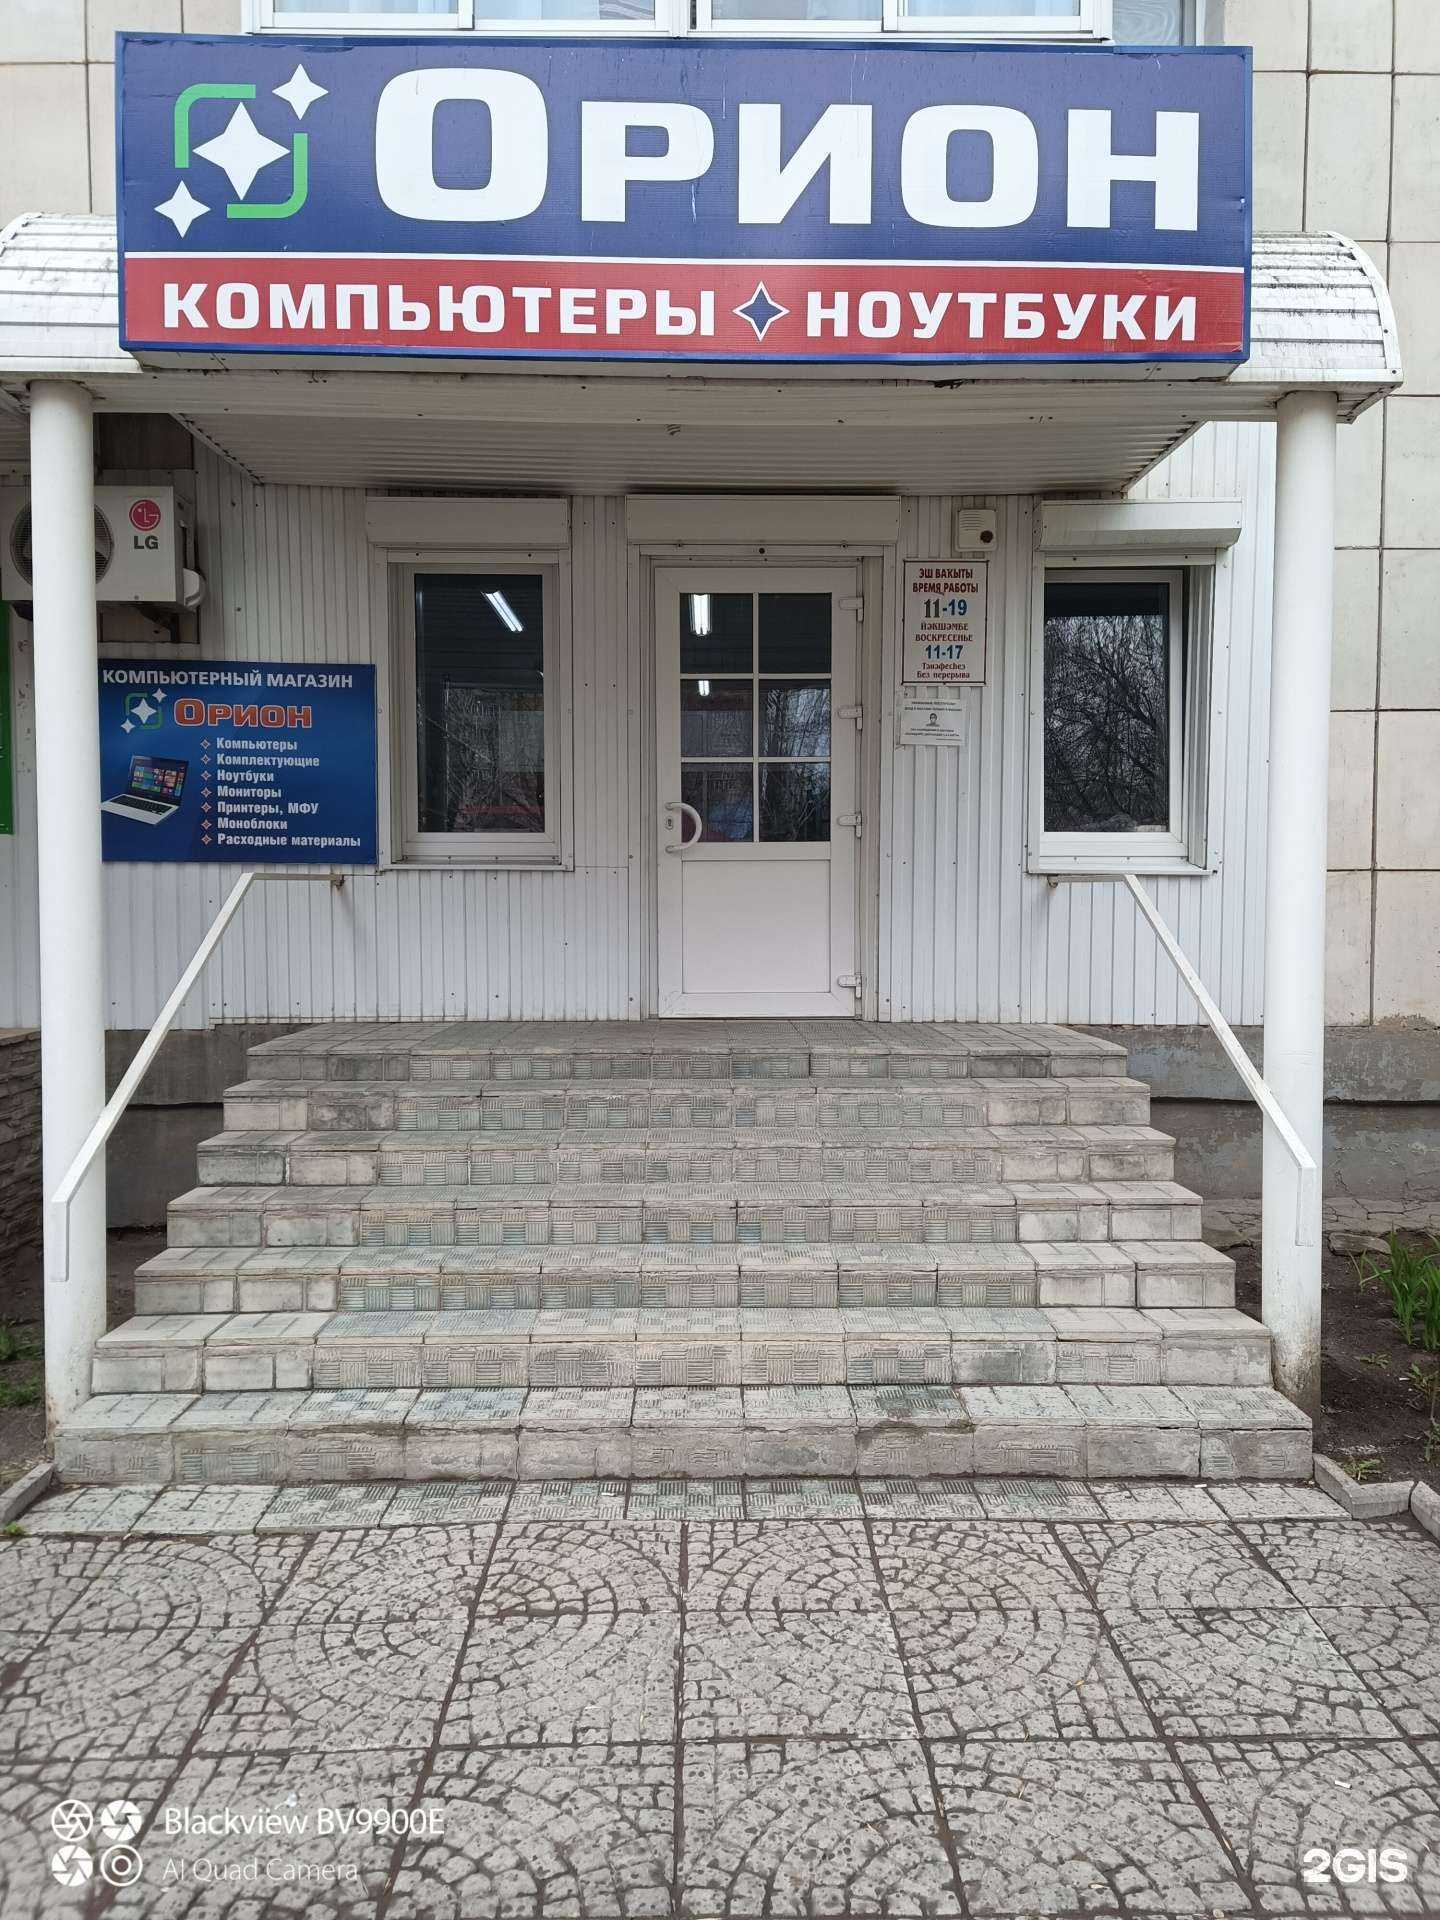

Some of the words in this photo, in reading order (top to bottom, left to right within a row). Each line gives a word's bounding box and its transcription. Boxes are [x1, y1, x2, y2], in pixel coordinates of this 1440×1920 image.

[162, 281, 716, 338] КОМПЬЮТЕРЫ
[805, 289, 1198, 342] НОУТБУКИ
[133, 535, 159, 550] LG
[919, 568, 933, 579] ЭШ
[912, 582, 941, 593] ВРЕМЯ
[943, 582, 979, 593] РАБОТЫ
[924, 598, 968, 618] 11-19
[915, 633, 973, 642] ВОСКРЕСЕНЬЕ
[925, 644, 964, 660] 11-17
[103, 669, 262, 687] КОМПЬЮТЕРНЫЙ
[266, 673, 353, 688] МАГАЗИН
[933, 672, 970, 680] перерыва
[216, 737, 298, 752] Компьютеры
[216, 753, 320, 768] Комплектующие
[217, 769, 274, 784] Ноутбуки
[217, 785, 282, 800] Мониторы
[217, 801, 284, 815] Принтеры,
[287, 802, 319, 814] МФУ
[217, 817, 288, 830] Моноблоки
[217, 833, 288, 847] Расходные
[291, 835, 361, 848] материалы
